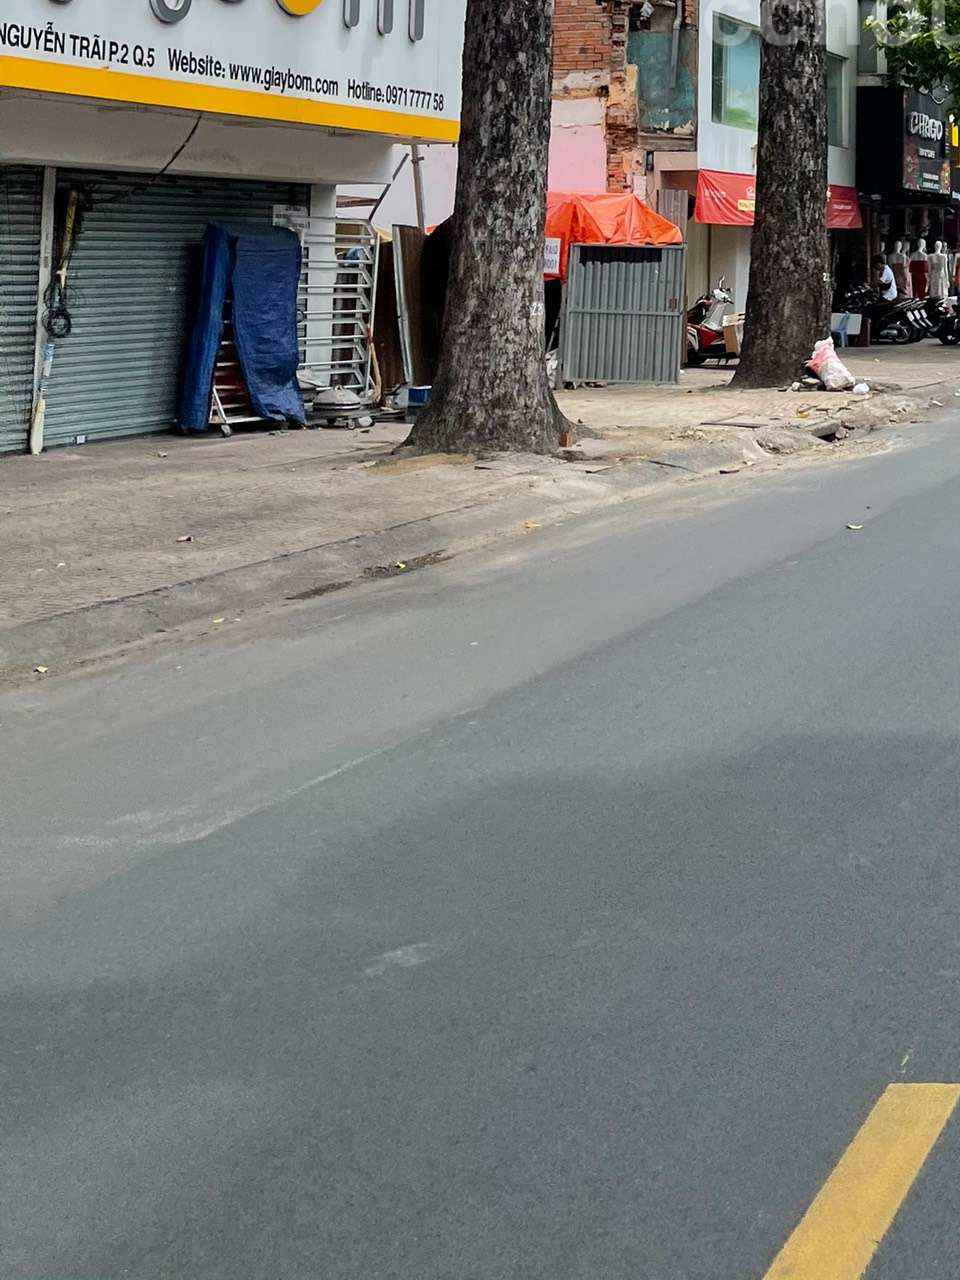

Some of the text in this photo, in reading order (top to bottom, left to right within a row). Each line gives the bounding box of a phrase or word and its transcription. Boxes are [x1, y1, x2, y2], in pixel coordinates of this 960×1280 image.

[70, 34, 106, 61] TRÃI
[109, 41, 129, 64] P.2
[133, 44, 155, 68] Q.5
[168, 47, 226, 79] Website:
[229, 63, 339, 97] www.giaybom.com
